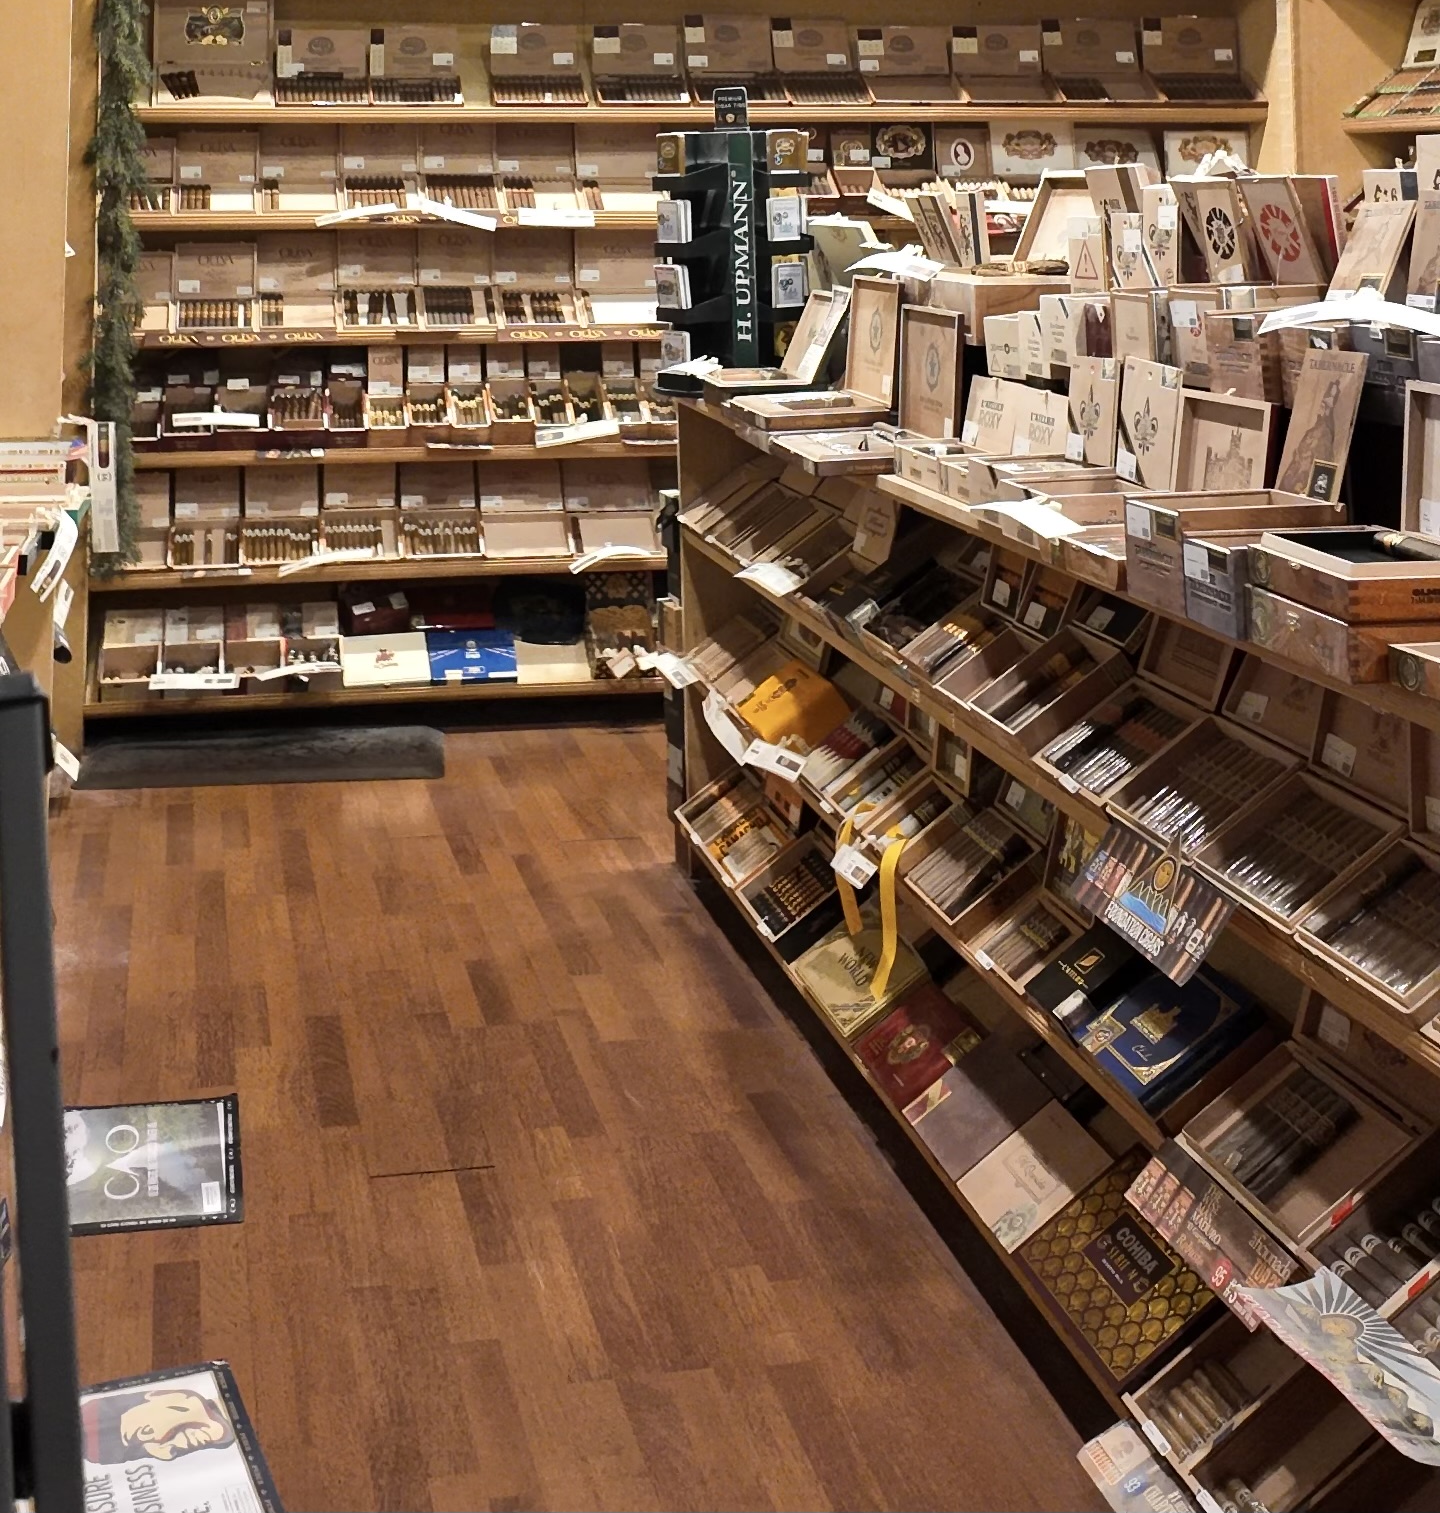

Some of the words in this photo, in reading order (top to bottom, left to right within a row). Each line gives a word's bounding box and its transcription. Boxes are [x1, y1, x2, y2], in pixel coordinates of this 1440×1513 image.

[733, 180, 751, 306] UPMANN
[737, 312, 752, 343] H.
[1310, 358, 1356, 373] TABERNACLE
[979, 410, 1002, 430] ROXY
[1028, 423, 1054, 445] ROXY
[1137, 928, 1165, 957] CIGARS
[838, 952, 868, 986] WORLD
[104, 1124, 140, 1200] CAO
[1191, 1210, 1221, 1245] MADURO
[1116, 1227, 1159, 1274] COHIBA
[1211, 1265, 1227, 1287] 95
[86, 1473, 118, 1513] SURE
[124, 1464, 164, 1513] SINESS
